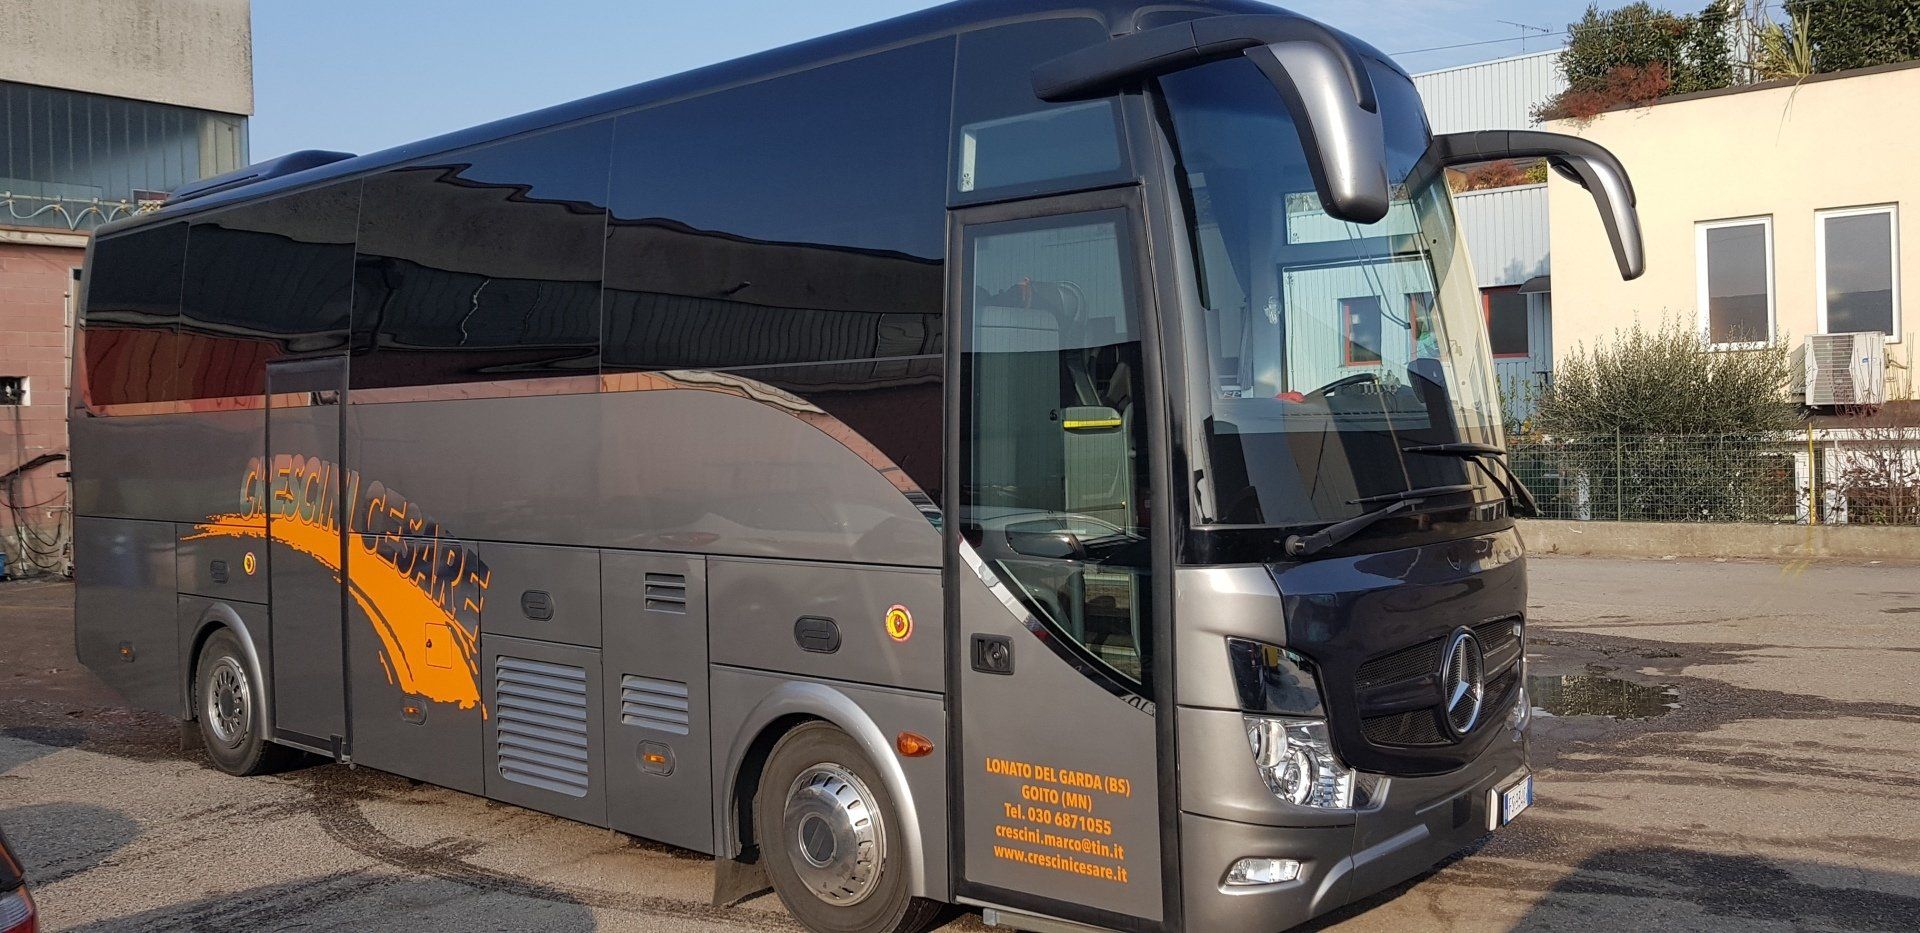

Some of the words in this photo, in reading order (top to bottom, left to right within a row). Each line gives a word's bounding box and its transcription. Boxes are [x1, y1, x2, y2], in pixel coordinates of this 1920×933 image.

[240, 454, 359, 535] CRESCINI
[361, 480, 491, 642] CESARE
[986, 757, 1032, 778] LONATO
[1035, 765, 1057, 783] DEL
[1059, 769, 1102, 790] GARDA
[1104, 776, 1131, 797] (BS)
[1021, 784, 1059, 804] GOITO
[1061, 791, 1092, 813] (MN)
[1004, 802, 1026, 820] Tel.
[1028, 807, 1052, 824] 030
[1054, 811, 1112, 835] 6871055
[995, 824, 1124, 860] crescini.marco@tin.it
[994, 845, 1128, 883] www.crescinicesare.it
